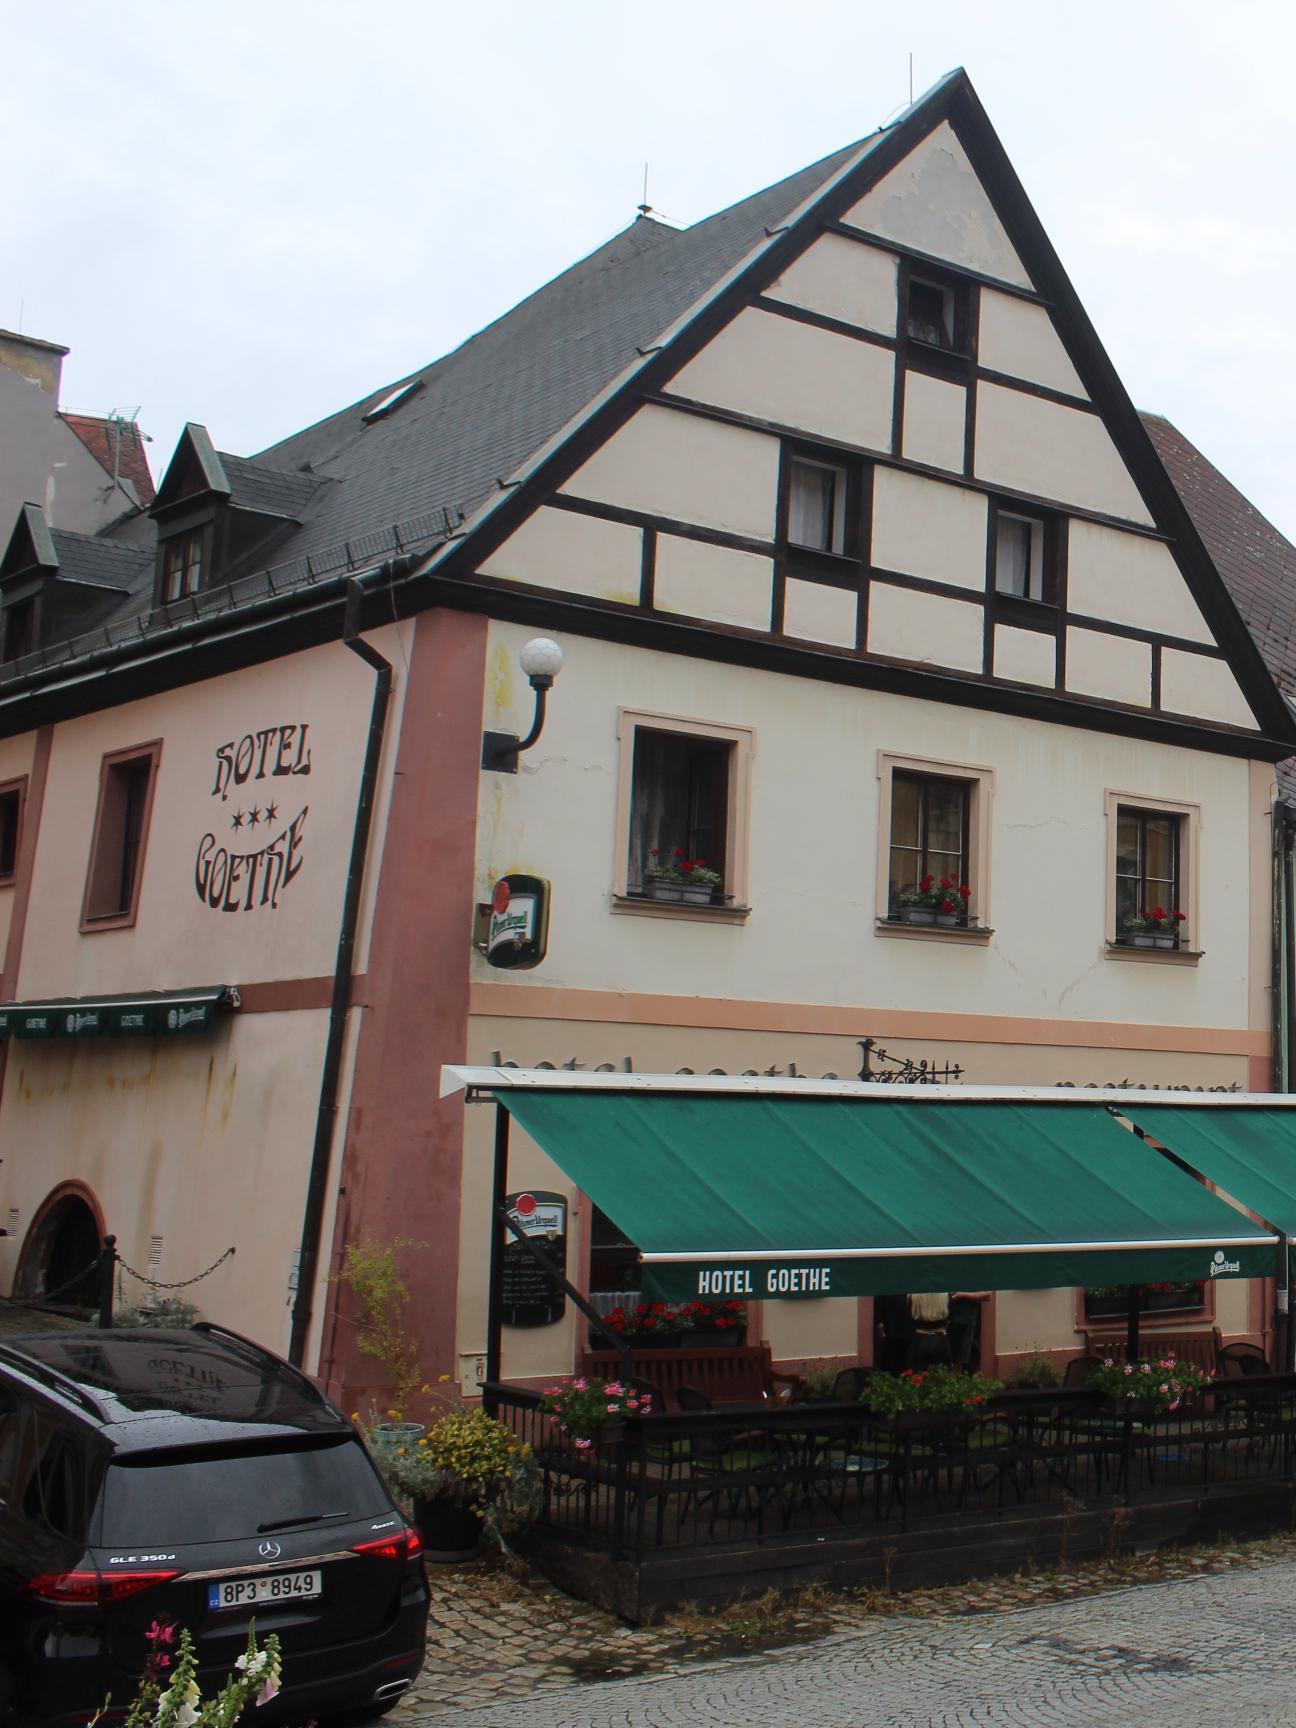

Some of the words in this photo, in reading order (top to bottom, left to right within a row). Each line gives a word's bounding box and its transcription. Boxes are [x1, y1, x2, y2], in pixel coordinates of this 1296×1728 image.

[211, 723, 312, 802] HOTEL
[194, 804, 310, 913] GOETHE
[698, 1269, 754, 1295] HOTEL
[766, 1267, 831, 1293] GOETHE
[109, 1555, 138, 1564] GLE
[140, 1553, 176, 1562] 350d
[223, 1581, 257, 1603] 8P3
[270, 1573, 314, 1597] 8949
